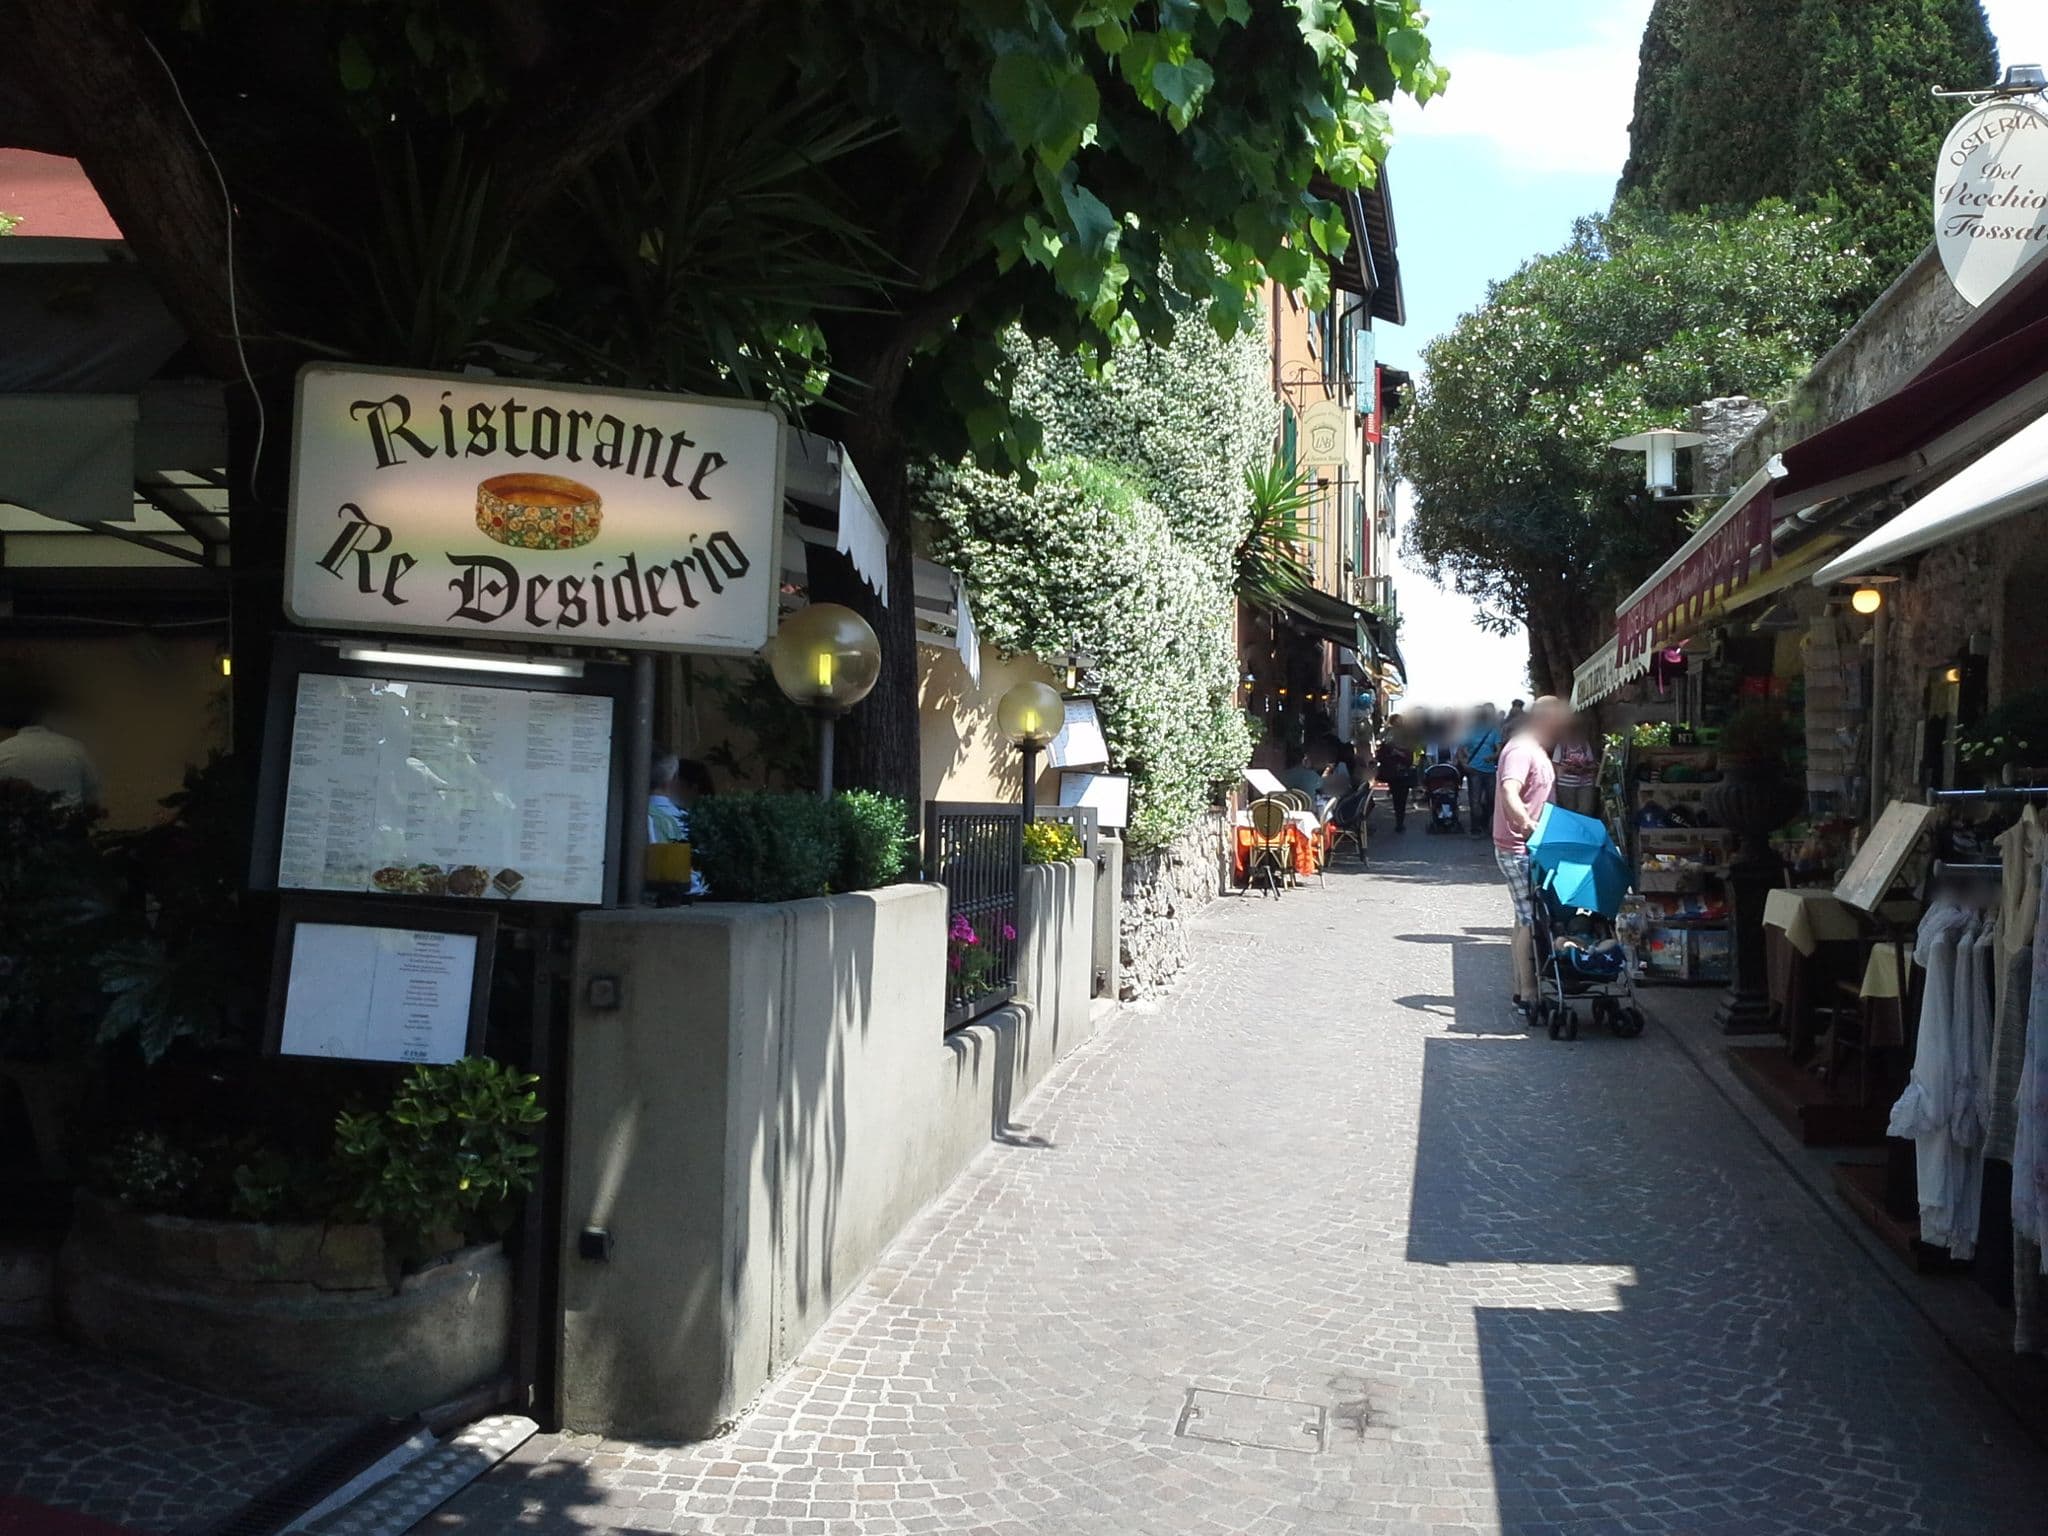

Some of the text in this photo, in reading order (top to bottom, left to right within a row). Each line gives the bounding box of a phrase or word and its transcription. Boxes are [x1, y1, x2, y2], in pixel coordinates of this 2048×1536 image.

[1950, 115, 2038, 167] OSTERIA
[1980, 162, 2022, 180] Del
[1940, 182, 2047, 209] Vecchio
[1944, 214, 2048, 240] Fossat
[349, 391, 728, 500] Ristorante
[315, 502, 751, 630] Re Desiderio
